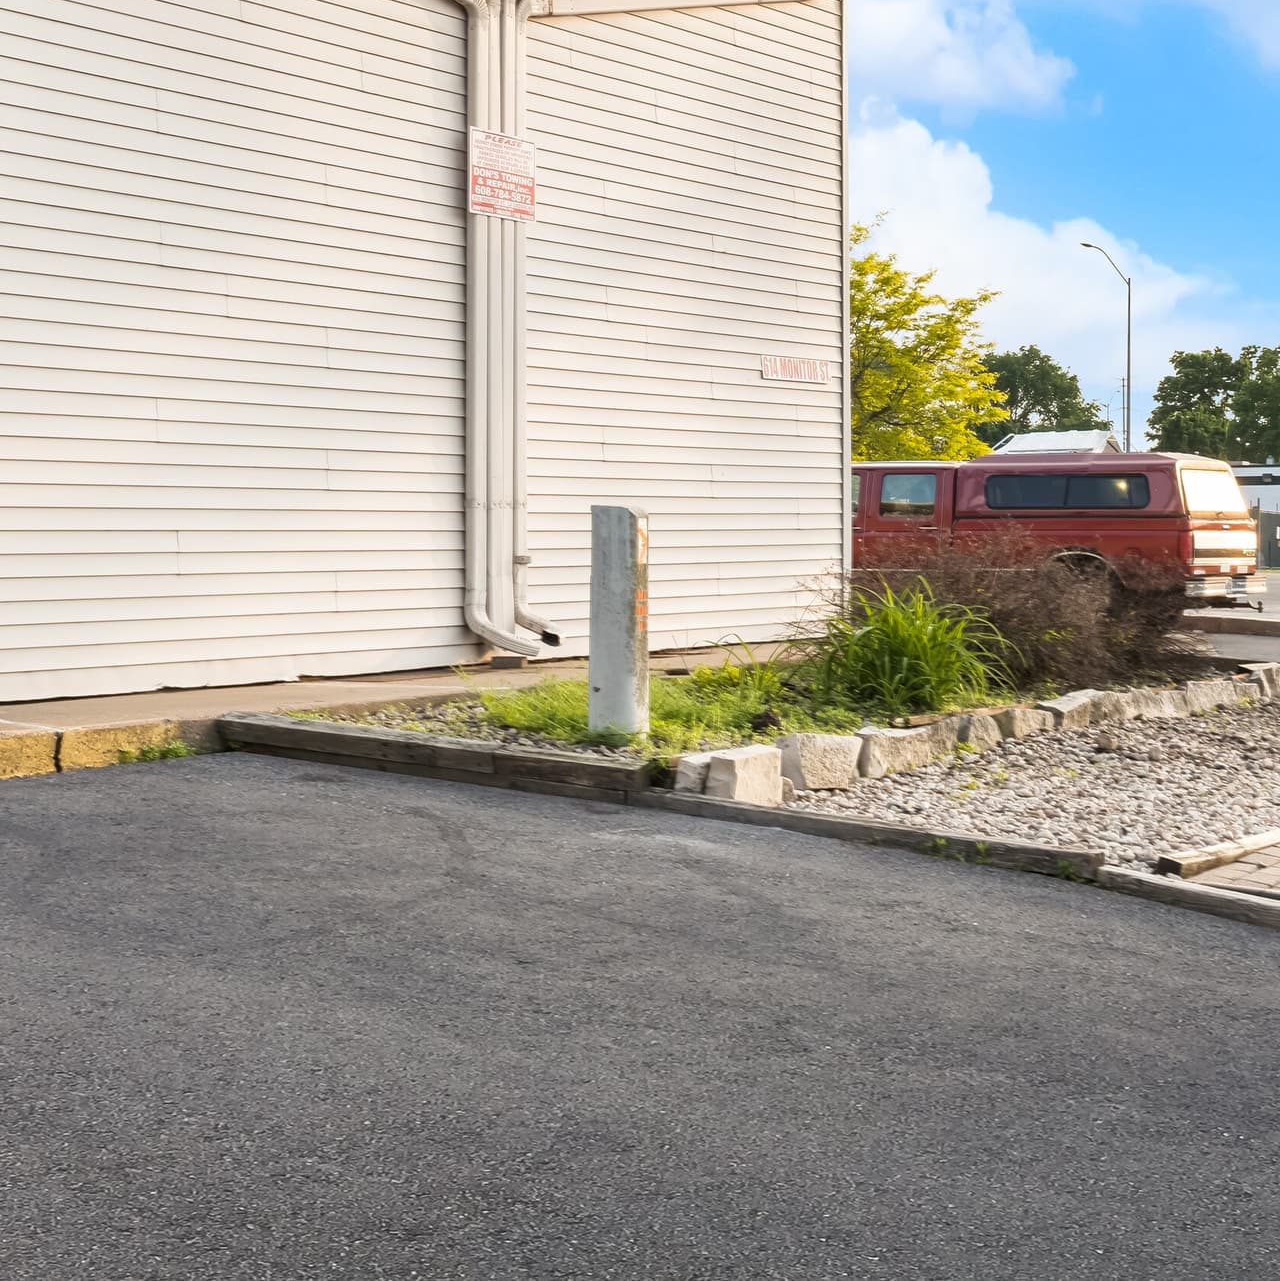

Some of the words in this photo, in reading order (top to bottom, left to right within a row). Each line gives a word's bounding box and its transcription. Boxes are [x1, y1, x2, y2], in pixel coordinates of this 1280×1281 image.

[484, 134, 522, 147] PLEASE
[474, 167, 499, 179] DON'S
[501, 172, 533, 187] TOWING
